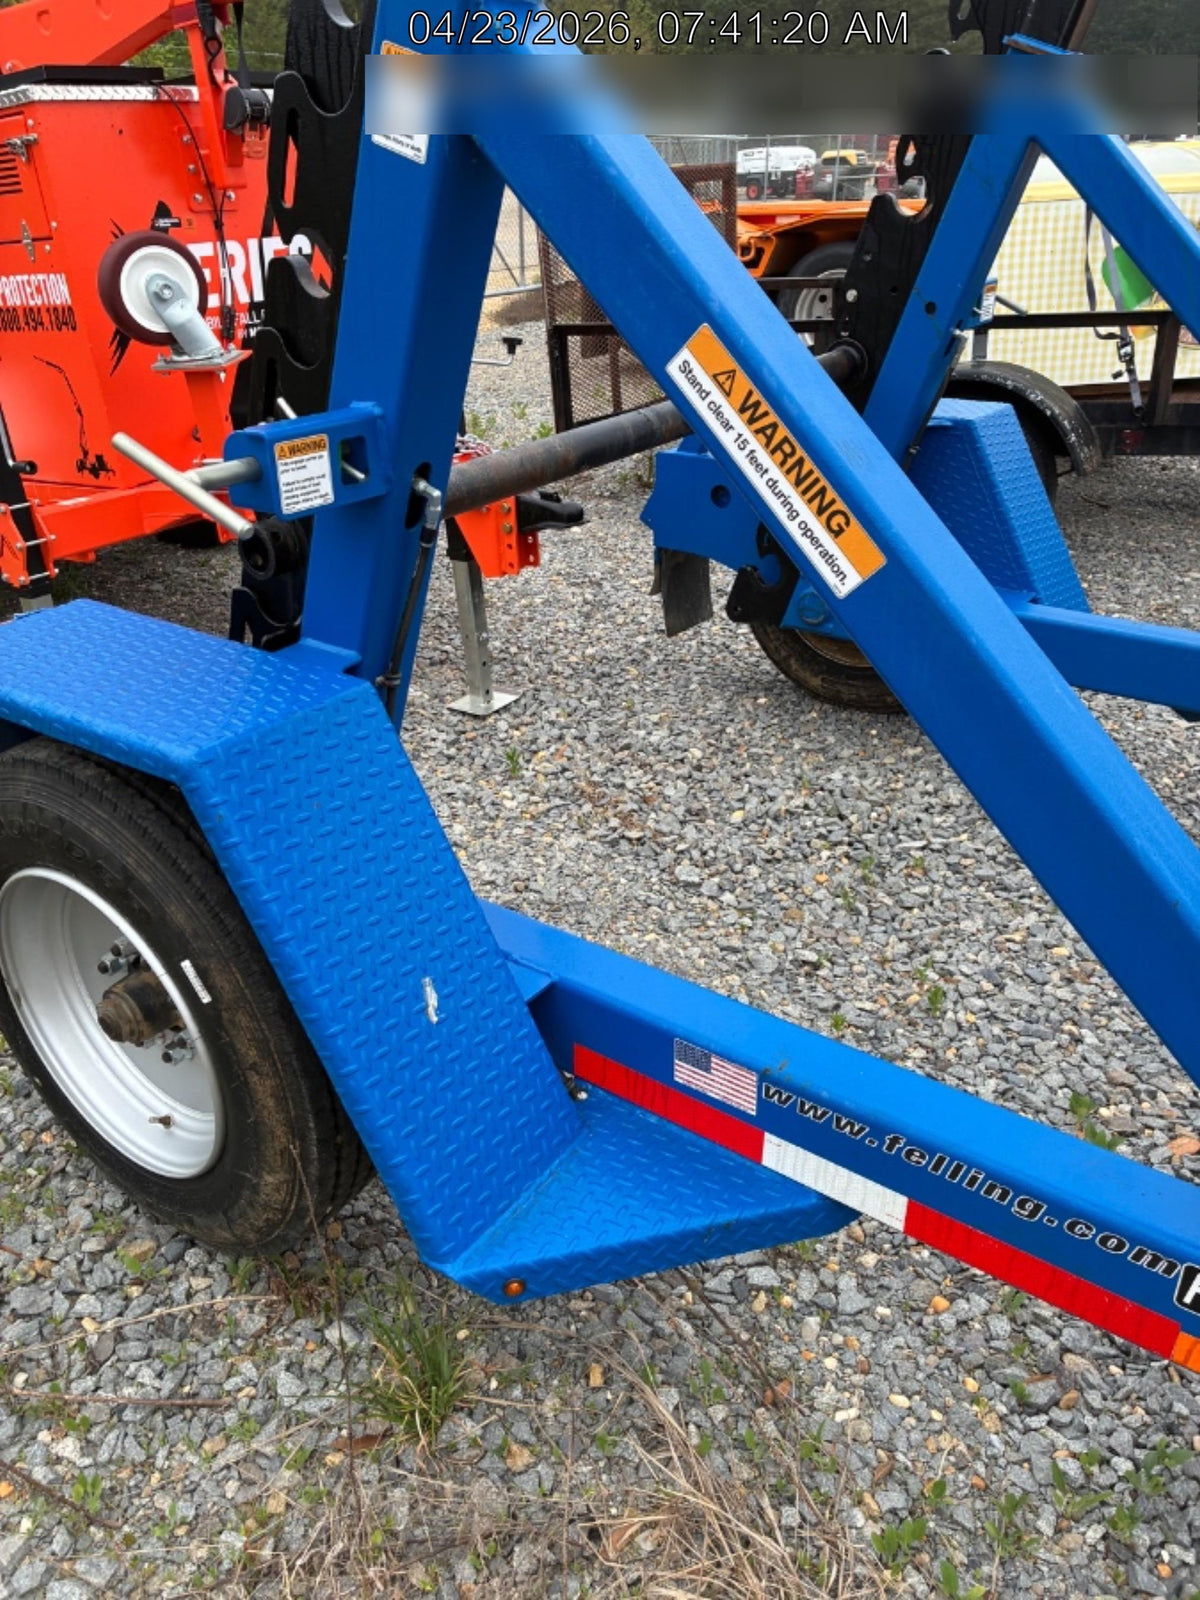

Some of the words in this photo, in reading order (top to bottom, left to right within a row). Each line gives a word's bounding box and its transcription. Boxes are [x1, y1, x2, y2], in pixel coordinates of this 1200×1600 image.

[186, 233, 312, 309] ERI
[288, 438, 327, 456] WARNING
[678, 359, 712, 402] Stand
[707, 400, 735, 433] clear
[733, 432, 750, 451] 15
[745, 449, 769, 479] feet
[765, 477, 801, 522] during
[798, 520, 847, 586] operation.
[738, 388, 851, 540] WARNING
[762, 1081, 1181, 1279] www.felling.com
